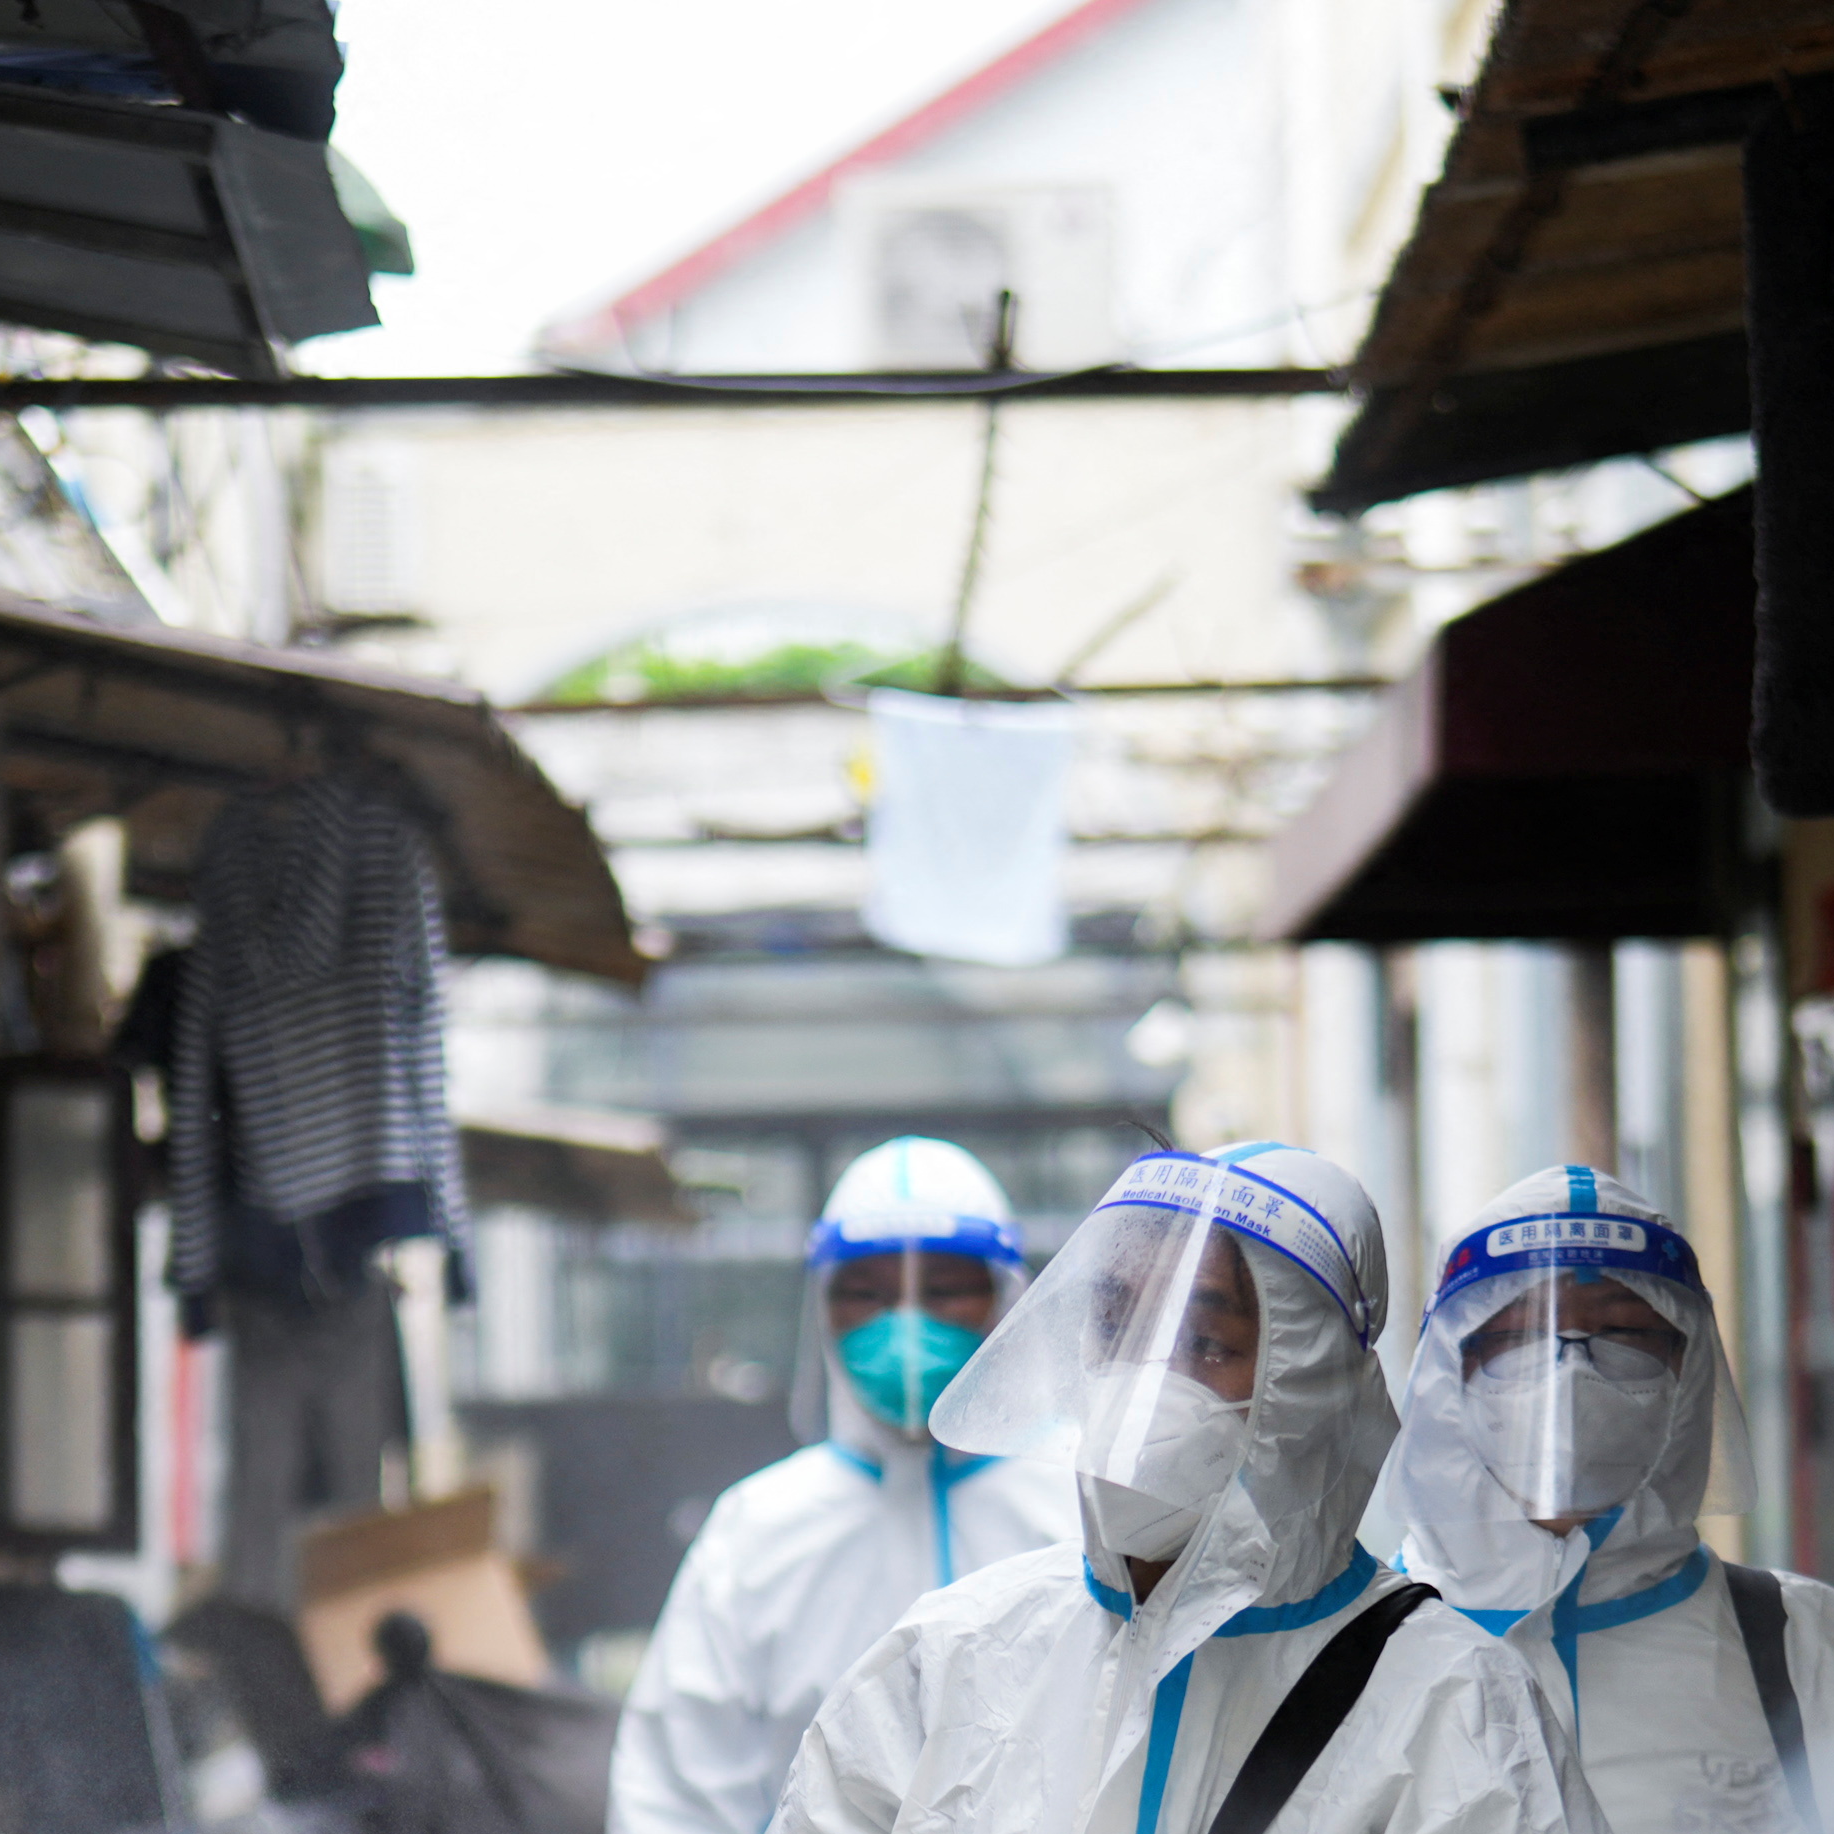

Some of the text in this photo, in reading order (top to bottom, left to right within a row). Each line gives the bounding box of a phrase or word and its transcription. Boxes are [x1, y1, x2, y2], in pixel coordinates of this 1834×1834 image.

[1120, 1188, 1271, 1237] Medical Isolaon Mask
[1127, 1164, 1284, 1219] 医用隔离面罩
[1499, 1221, 1634, 1246] 医用隔离面罩
